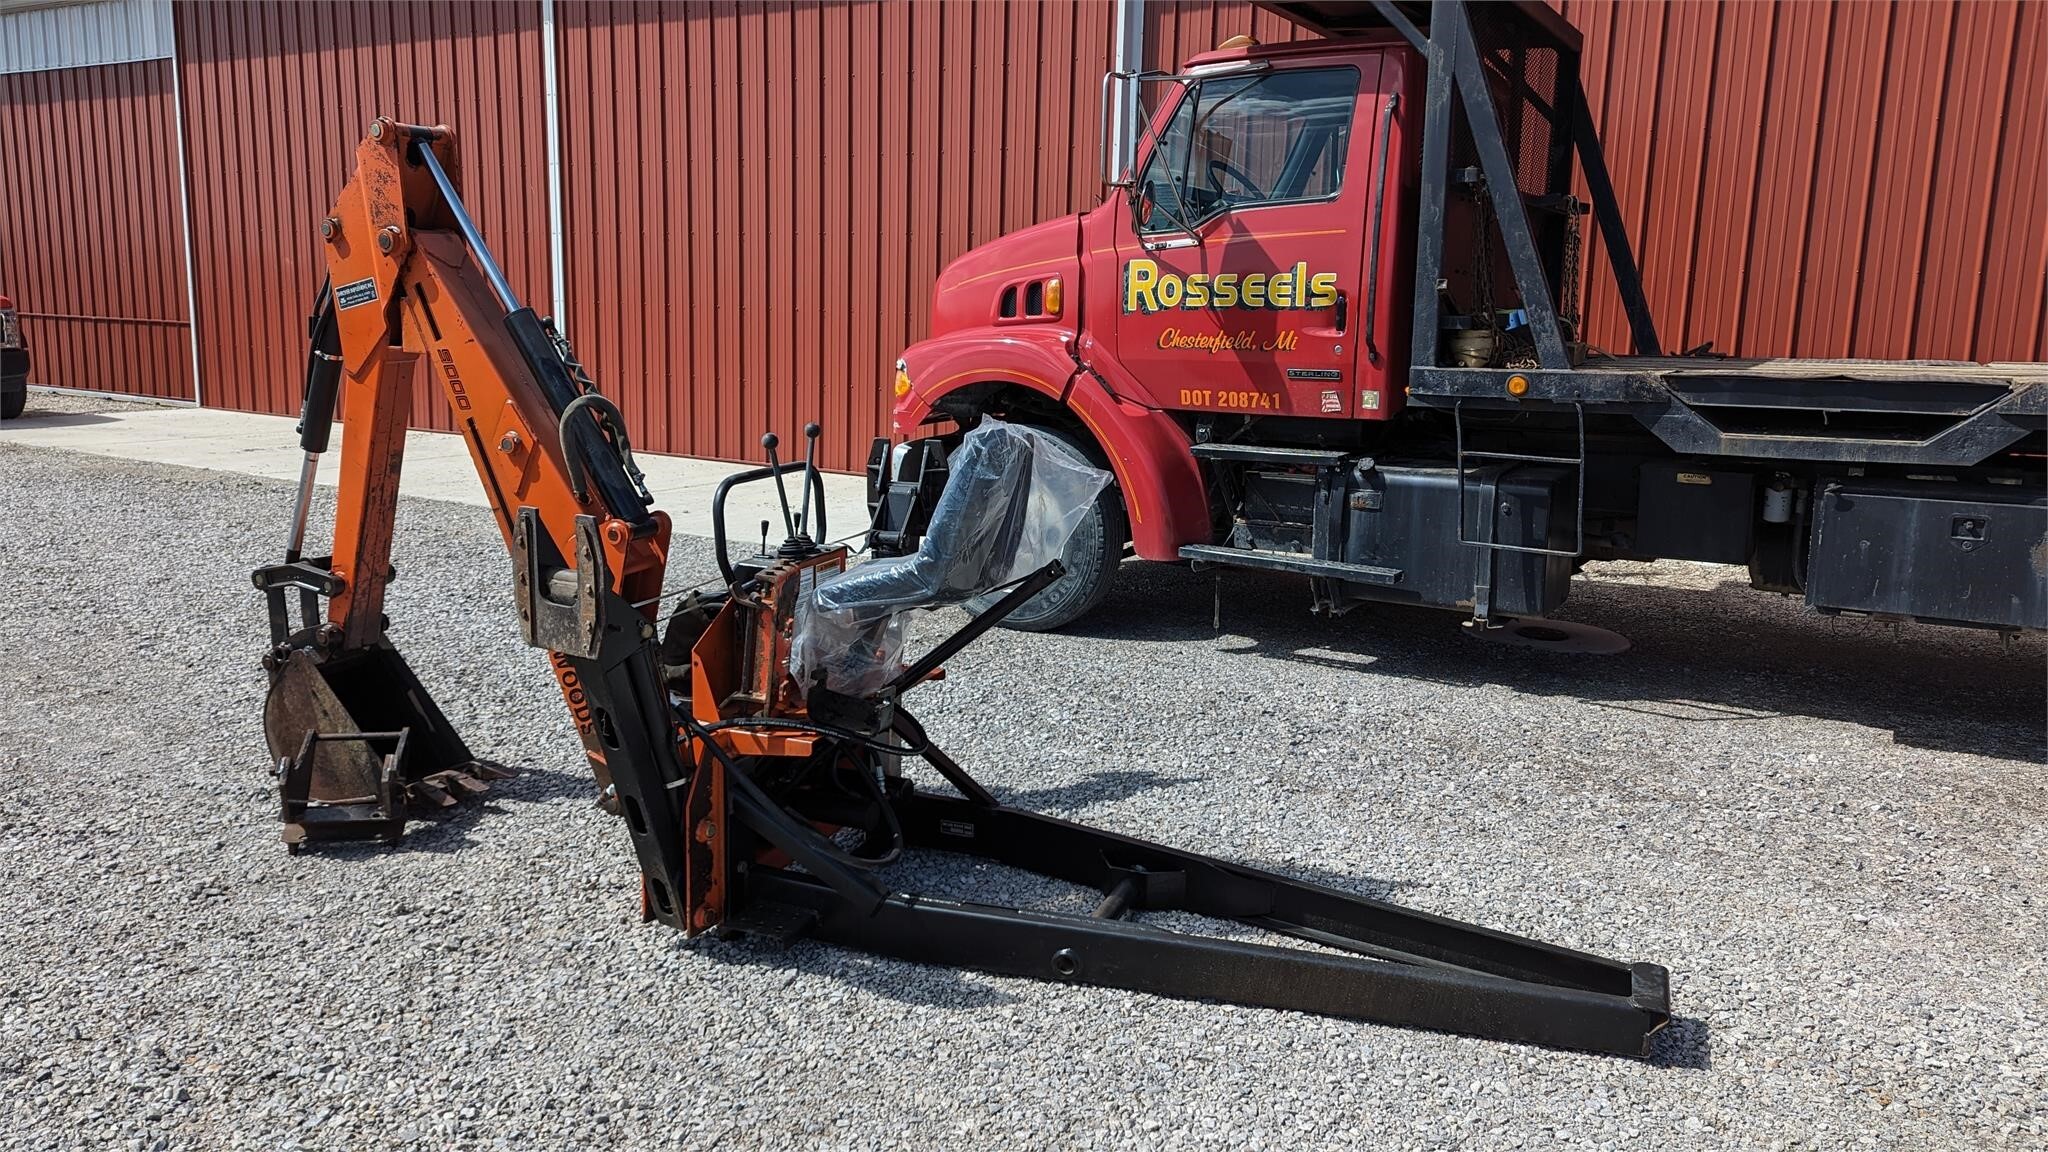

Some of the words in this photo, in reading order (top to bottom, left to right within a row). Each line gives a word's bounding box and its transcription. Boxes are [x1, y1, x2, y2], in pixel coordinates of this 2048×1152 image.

[1159, 328, 1256, 353] Chesterfield,
[1263, 330, 1298, 350] Mi
[1289, 370, 1338, 378] STERLING
[1180, 389, 1212, 406] DOT
[1218, 391, 1280, 409] 208741
